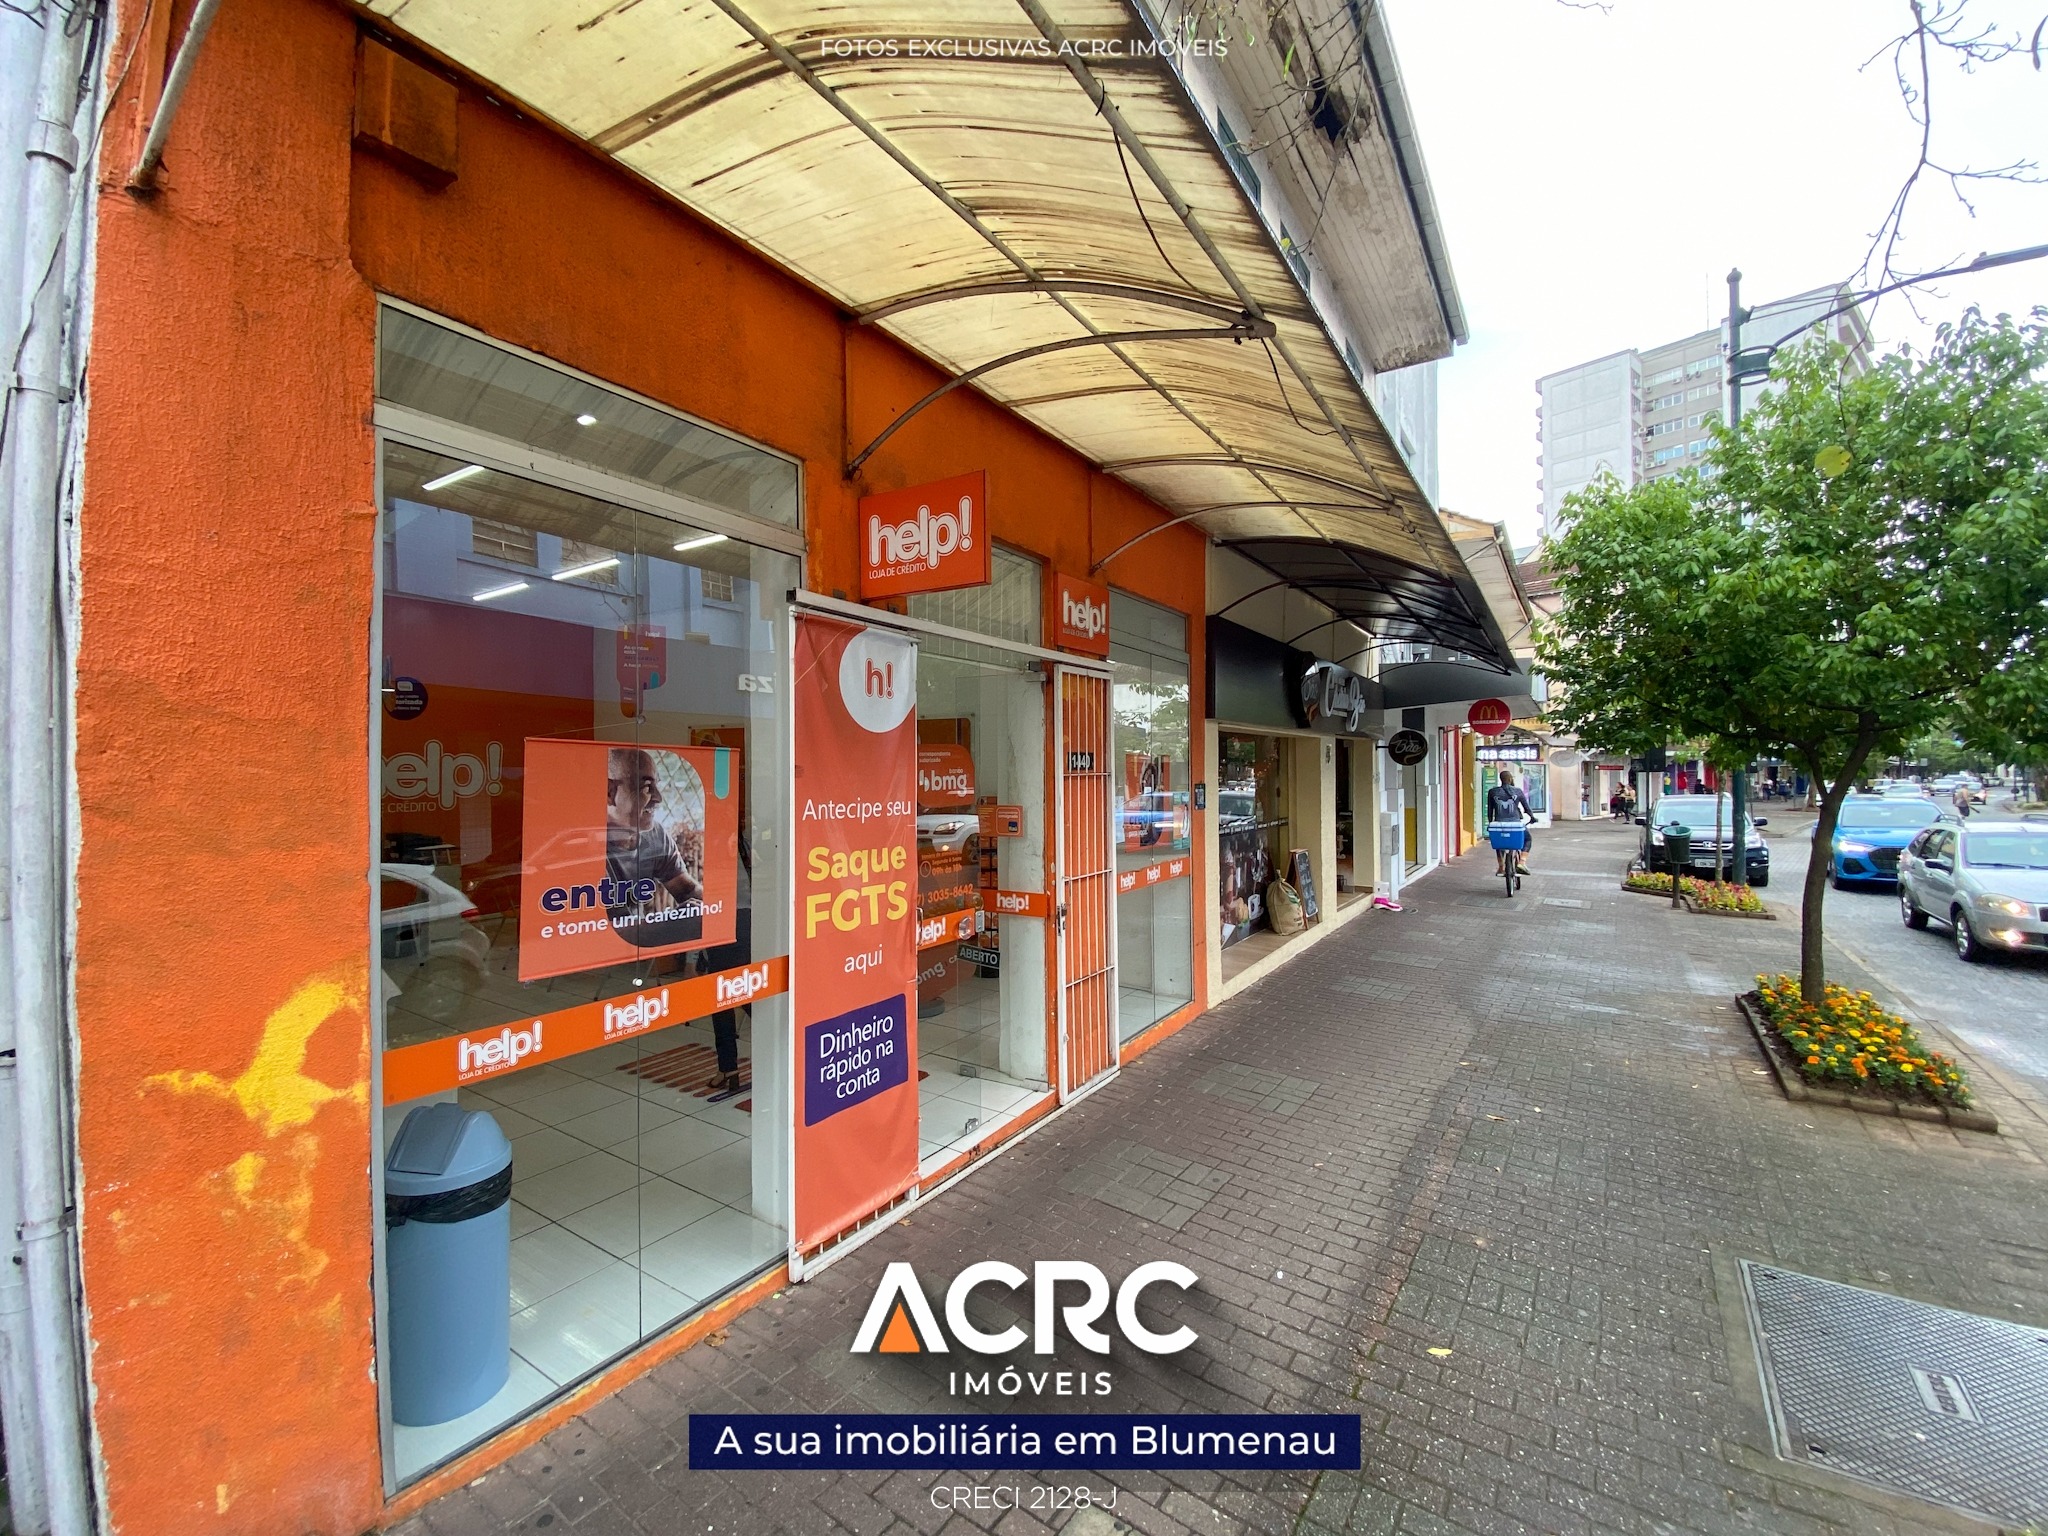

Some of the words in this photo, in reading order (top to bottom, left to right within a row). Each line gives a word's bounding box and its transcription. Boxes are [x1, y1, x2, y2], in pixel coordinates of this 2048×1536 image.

[869, 495, 972, 569] help!
[869, 569, 886, 579] LOJA
[886, 566, 895, 577] DE
[896, 562, 926, 575] CRÉDITO
[1063, 588, 1106, 640] help!
[864, 657, 893, 700] h!
[380, 739, 503, 811] elp!
[931, 770, 967, 798] bmg
[802, 797, 882, 823] Antecipe
[886, 800, 911, 816] seu
[807, 845, 907, 883] Saque
[1120, 872, 1135, 889] help!
[1147, 865, 1160, 881] help!
[1170, 860, 1182, 875] help!
[539, 877, 657, 915] entre
[806, 881, 908, 939] FGTS
[996, 893, 1029, 911] help!
[541, 925, 553, 939] e
[557, 918, 608, 936] tome
[612, 914, 642, 929] um
[645, 900, 723, 924] cafezinho!
[844, 943, 882, 975] aqui
[960, 947, 998, 964] ABERTO
[717, 962, 769, 1001] help!
[604, 988, 669, 1033] help!
[458, 1020, 543, 1072] help!
[820, 1015, 893, 1059] Dinheiro
[458, 1072, 474, 1081] LOJA
[474, 1068, 483, 1076] DE
[483, 1061, 510, 1073] CRÉDITO
[820, 1046, 871, 1083] rápido
[876, 1039, 893, 1059] na
[836, 1067, 880, 1099] conta
